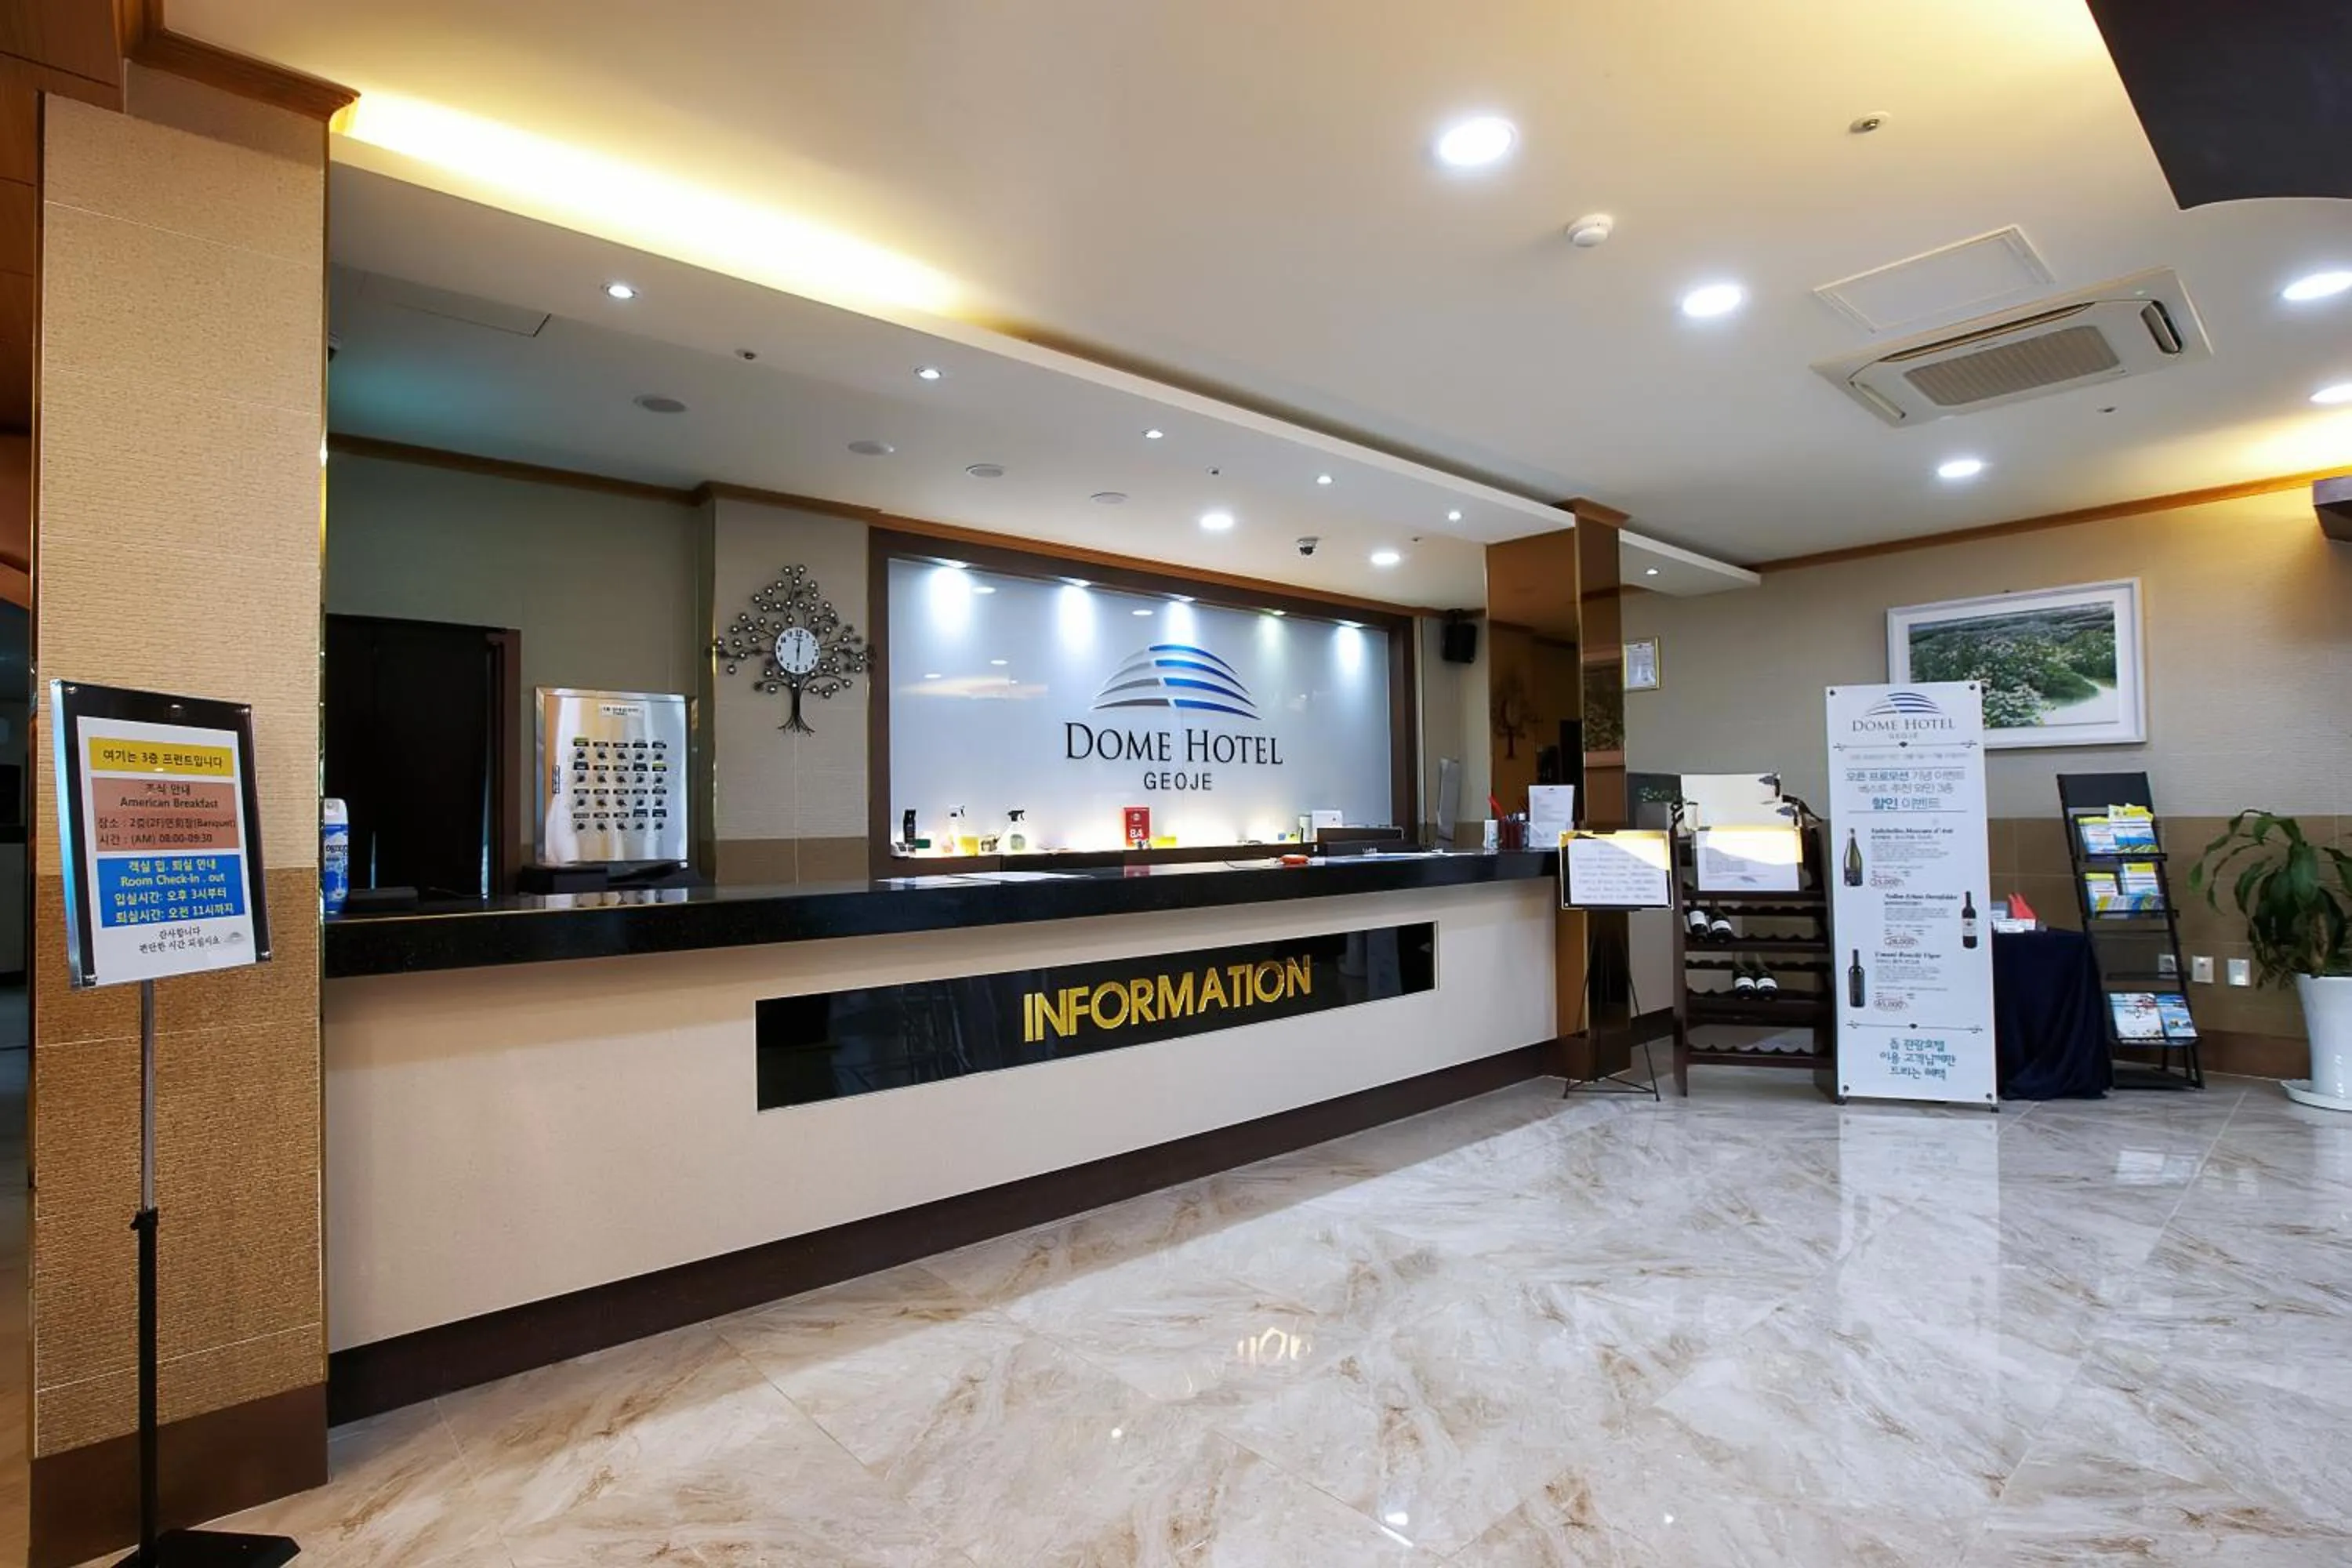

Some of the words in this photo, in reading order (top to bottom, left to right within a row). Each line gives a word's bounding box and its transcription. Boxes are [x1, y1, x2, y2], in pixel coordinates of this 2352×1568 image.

[1852, 720, 1898, 731] DOME
[1904, 717, 1956, 730] HOTEL
[1065, 721, 1173, 761] DOME
[1185, 728, 1283, 765] HOTEL
[103, 750, 136, 764] 여기는
[140, 753, 158, 765] 3층
[1144, 771, 1213, 791] GEOJE
[170, 784, 191, 796] 안내
[120, 797, 170, 808] American
[173, 798, 218, 809] Breakfast
[99, 816, 119, 829] 장소
[100, 833, 120, 846] 시간
[120, 875, 153, 887] Room
[157, 873, 199, 886] Check-in
[209, 873, 225, 882] out
[167, 888, 187, 902] 오후
[1023, 953, 1312, 1043] INFORMATION
